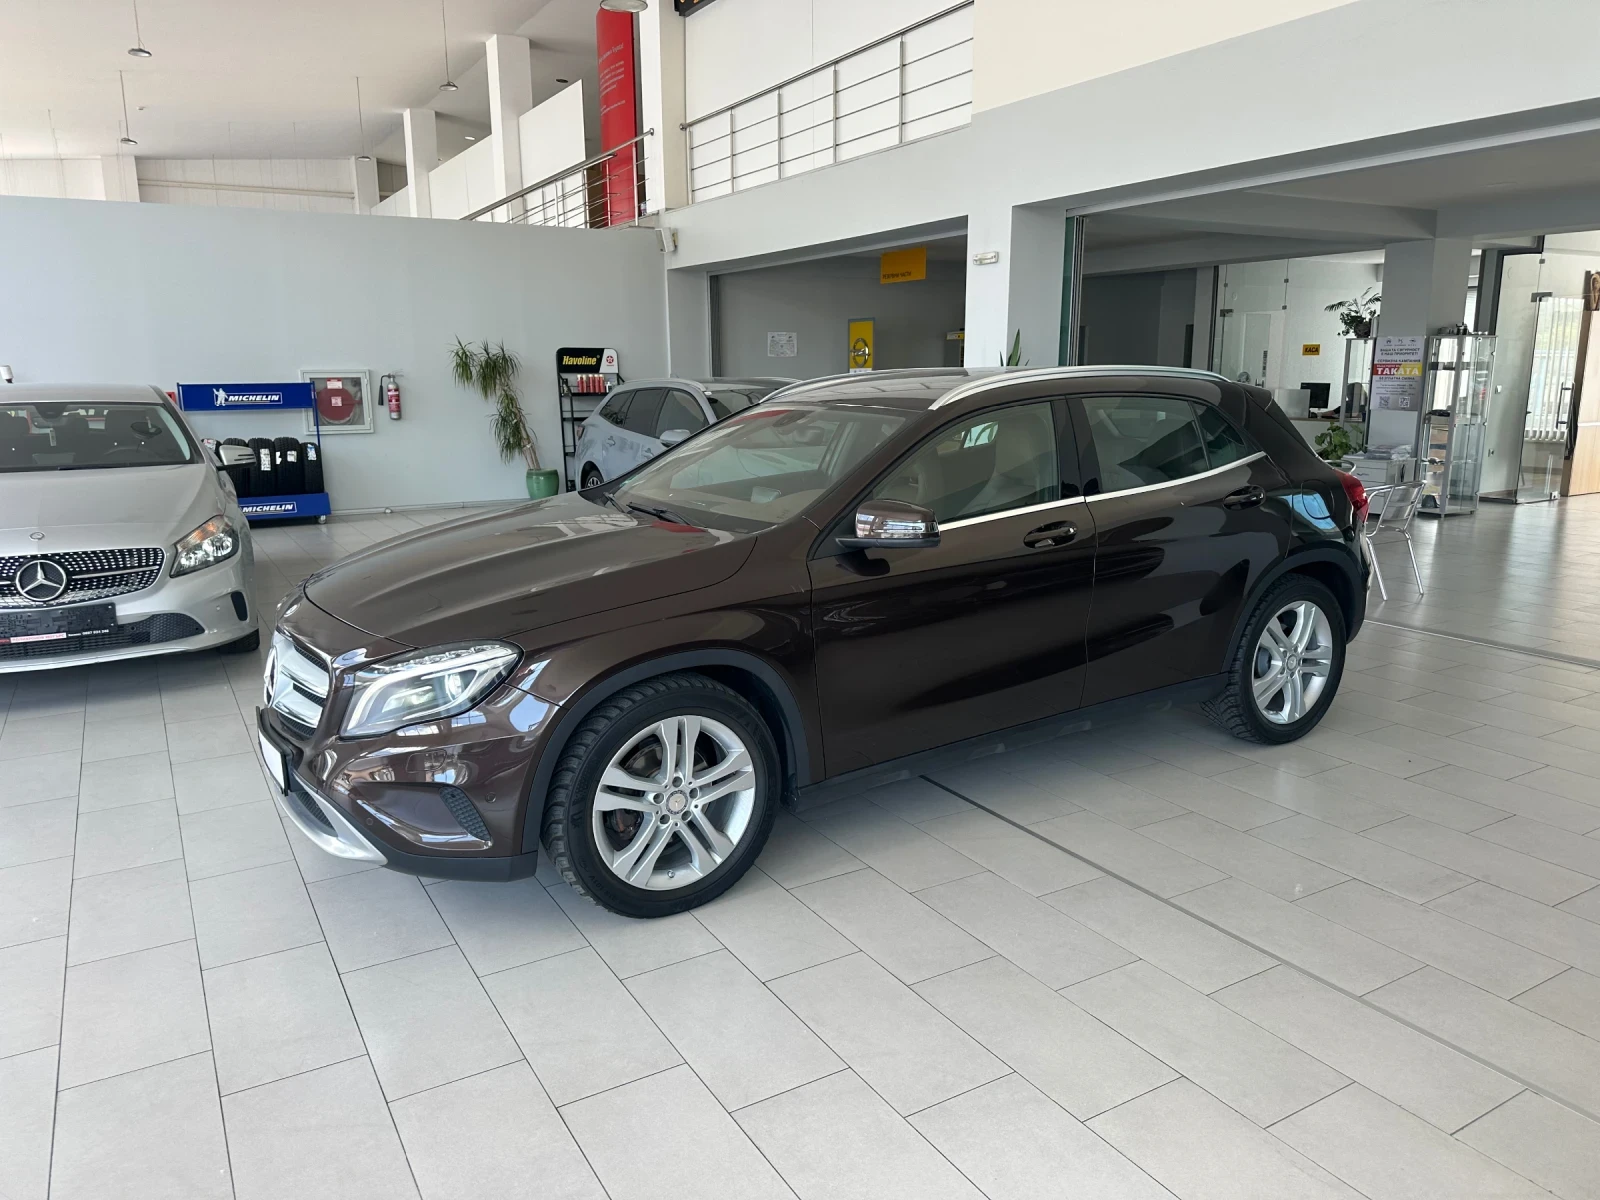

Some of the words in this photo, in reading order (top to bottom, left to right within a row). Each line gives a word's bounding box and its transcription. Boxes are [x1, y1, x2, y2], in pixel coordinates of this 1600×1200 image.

[562, 355, 597, 365] Havoline
[228, 394, 280, 402] MICHELIN
[242, 504, 294, 513] MICHELIN
